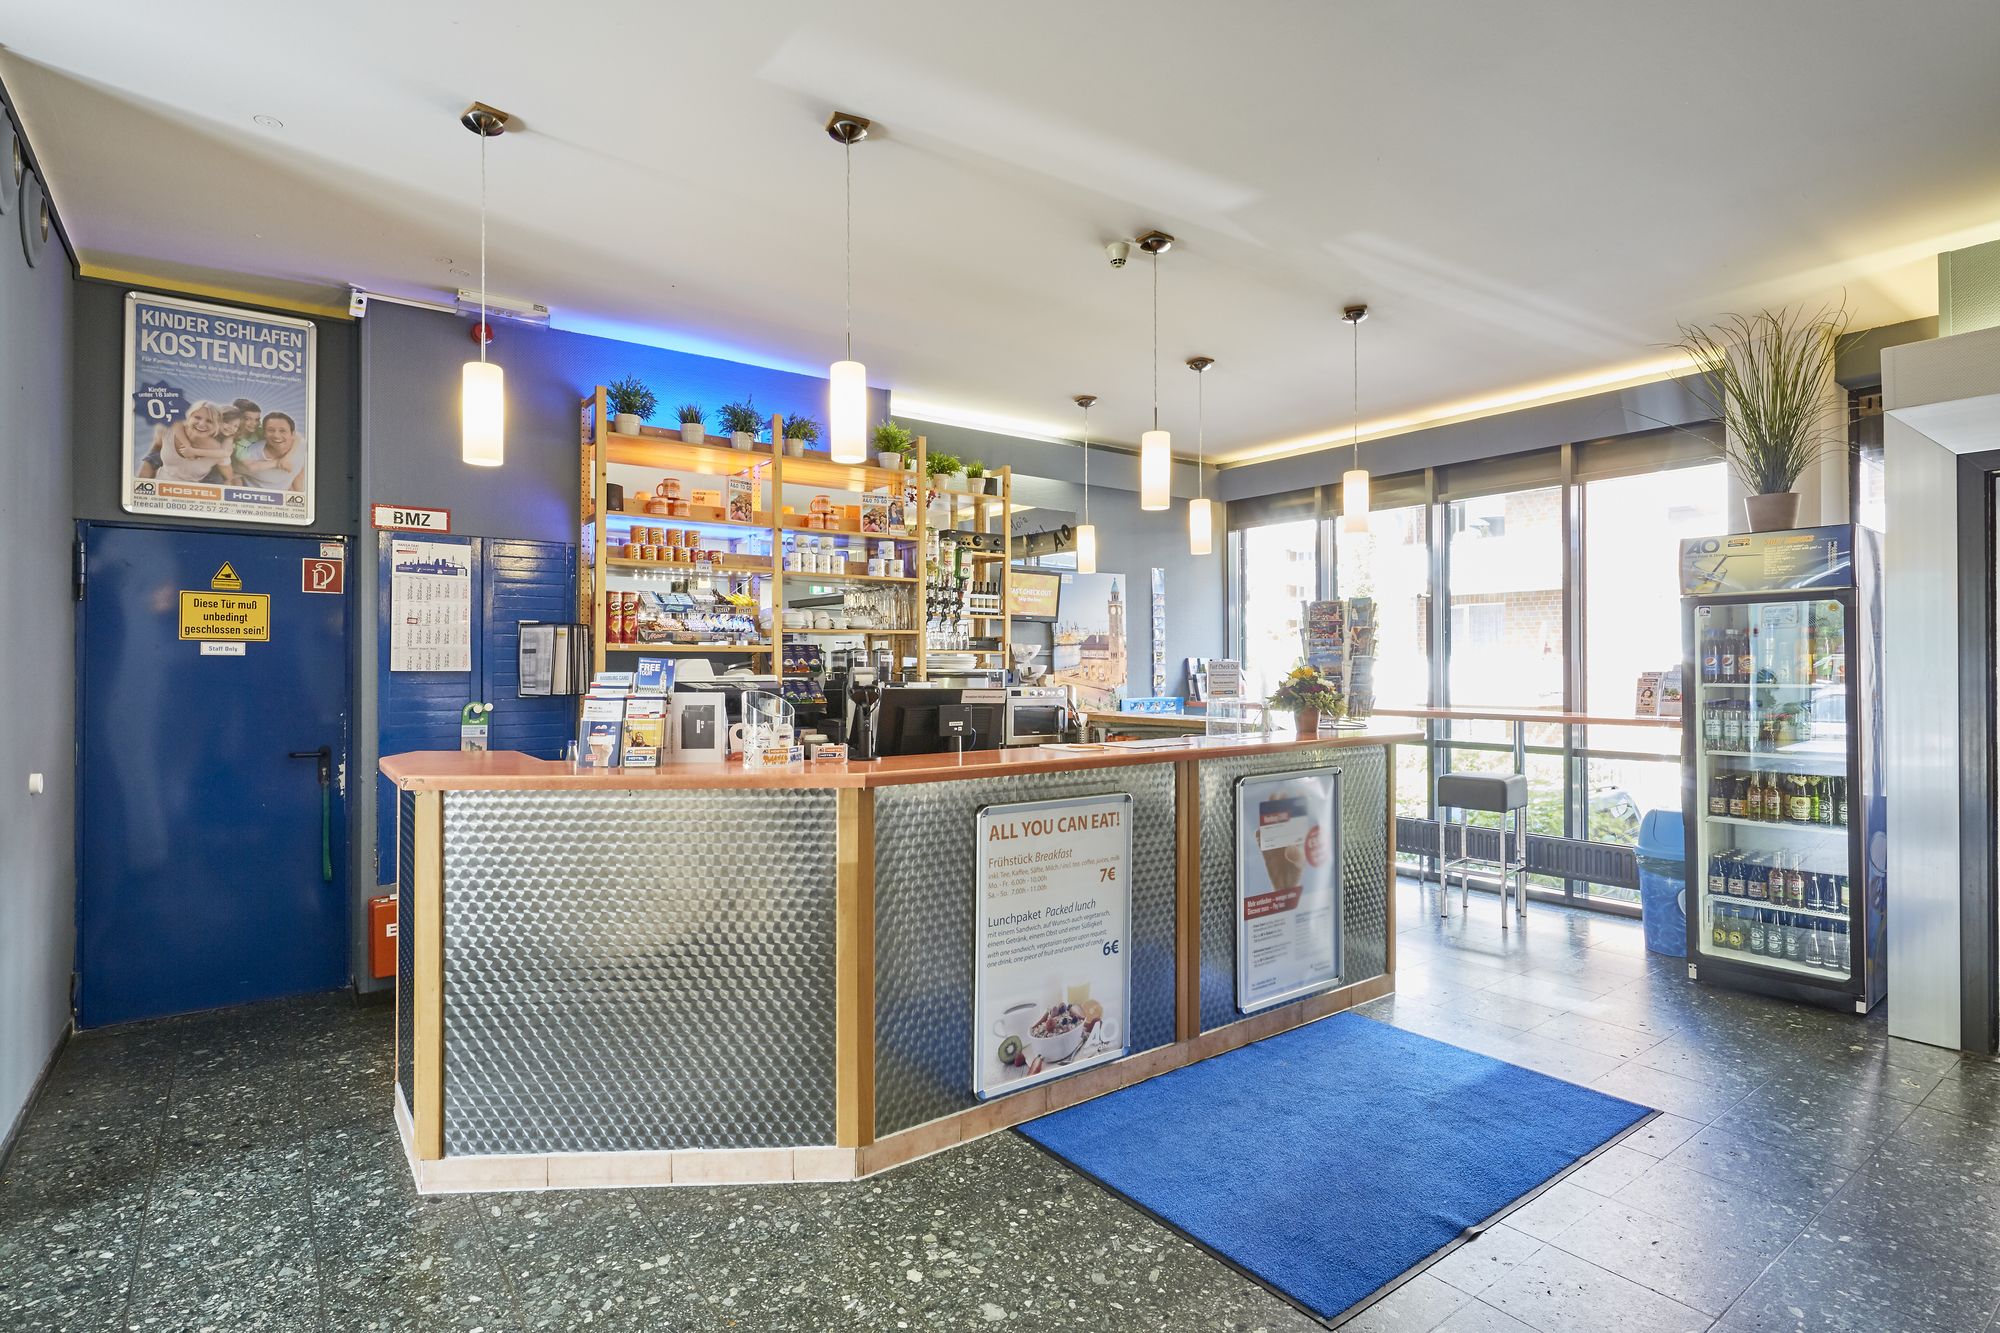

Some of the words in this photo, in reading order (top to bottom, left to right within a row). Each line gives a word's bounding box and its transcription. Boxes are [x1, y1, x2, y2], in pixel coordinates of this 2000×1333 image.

[142, 309, 208, 334] KINDER
[214, 320, 302, 348] SCHLAFEN
[141, 328, 302, 374] KOSTENLOS!
[162, 487, 217, 498] HOSTEL
[233, 492, 275, 502] HOTEL
[134, 500, 164, 509] freecall
[236, 509, 305, 518] www.aohostels.com
[393, 510, 431, 527] BMZ
[1686, 539, 1720, 554] AO
[193, 598, 219, 608] Diese
[221, 599, 236, 609] Tür
[238, 600, 257, 610] muß
[203, 612, 248, 624] unbedingt
[184, 625, 241, 635] geschlossen
[243, 626, 265, 635] sein!
[989, 823, 1018, 842] ALL
[1021, 819, 1054, 837] YOU
[1057, 815, 1088, 833] CAN
[1092, 812, 1120, 829] EAT!
[989, 853, 1033, 868] Frühstück
[1035, 849, 1073, 862] Breakfast
[1100, 867, 1116, 882] 7€
[988, 910, 1042, 927] Lunchpaket
[1045, 902, 1074, 918] Packed
[1074, 899, 1096, 912] lunch
[1016, 924, 1042, 934] Sandwich,
[1052, 918, 1070, 927] Wunsch
[1082, 910, 1111, 921] vegetarisch,
[987, 940, 1004, 948] einem
[1006, 935, 1027, 944] Getränk,
[1081, 920, 1103, 930] Süßigkeit
[987, 951, 999, 959] with
[1010, 945, 1036, 955] sandwich,
[1037, 940, 1062, 949] vegetarian
[1063, 936, 1077, 944] option
[1078, 934, 1089, 942] upon
[998, 958, 1013, 966] drink,
[1024, 952, 1037, 961] piece
[1043, 949, 1054, 957] fruit
[1054, 946, 1064, 954] and
[1073, 943, 1085, 951] piece
[1090, 938, 1104, 947] candy
[1103, 940, 1119, 956] 6€
